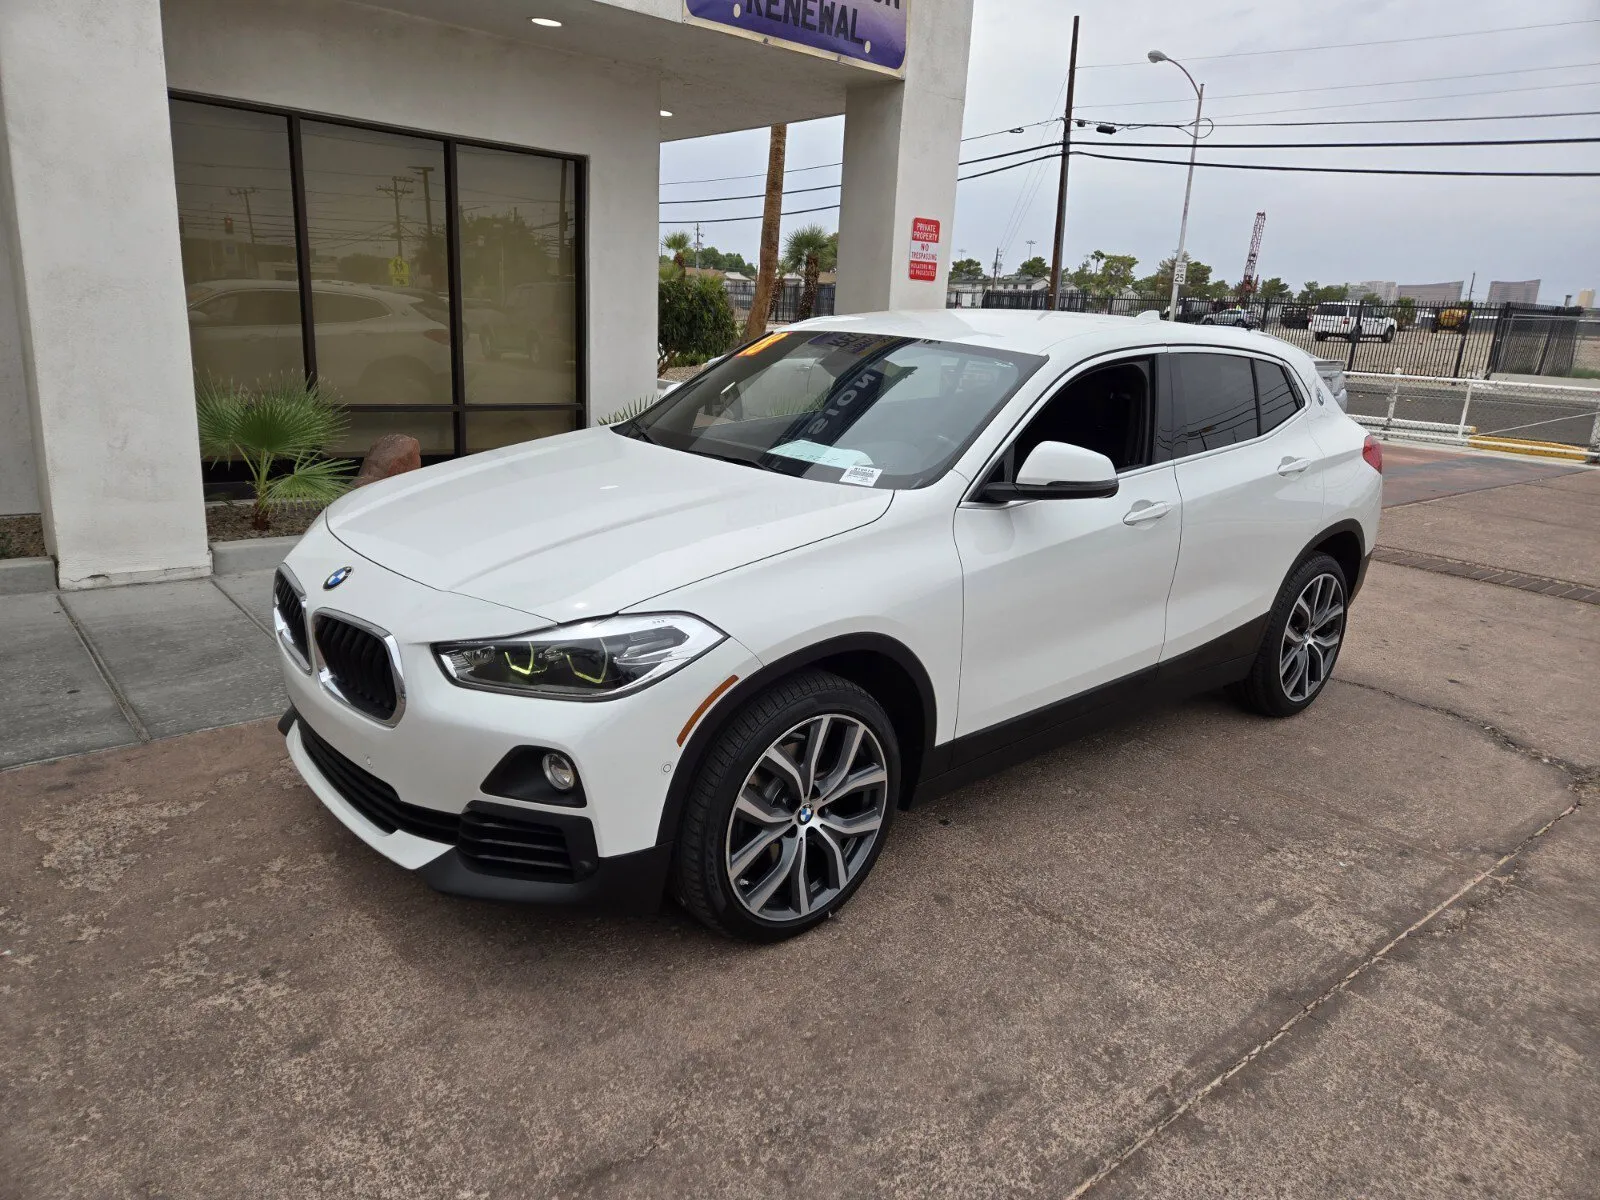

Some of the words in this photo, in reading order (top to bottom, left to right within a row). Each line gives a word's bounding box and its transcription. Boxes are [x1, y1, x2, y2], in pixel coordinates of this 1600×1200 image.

[916, 222, 937, 233] PRIVATE
[913, 231, 938, 242] PROPERTY
[920, 243, 930, 252] NO
[911, 251, 937, 261] TRESPASSING
[1174, 273, 1185, 283] 25
